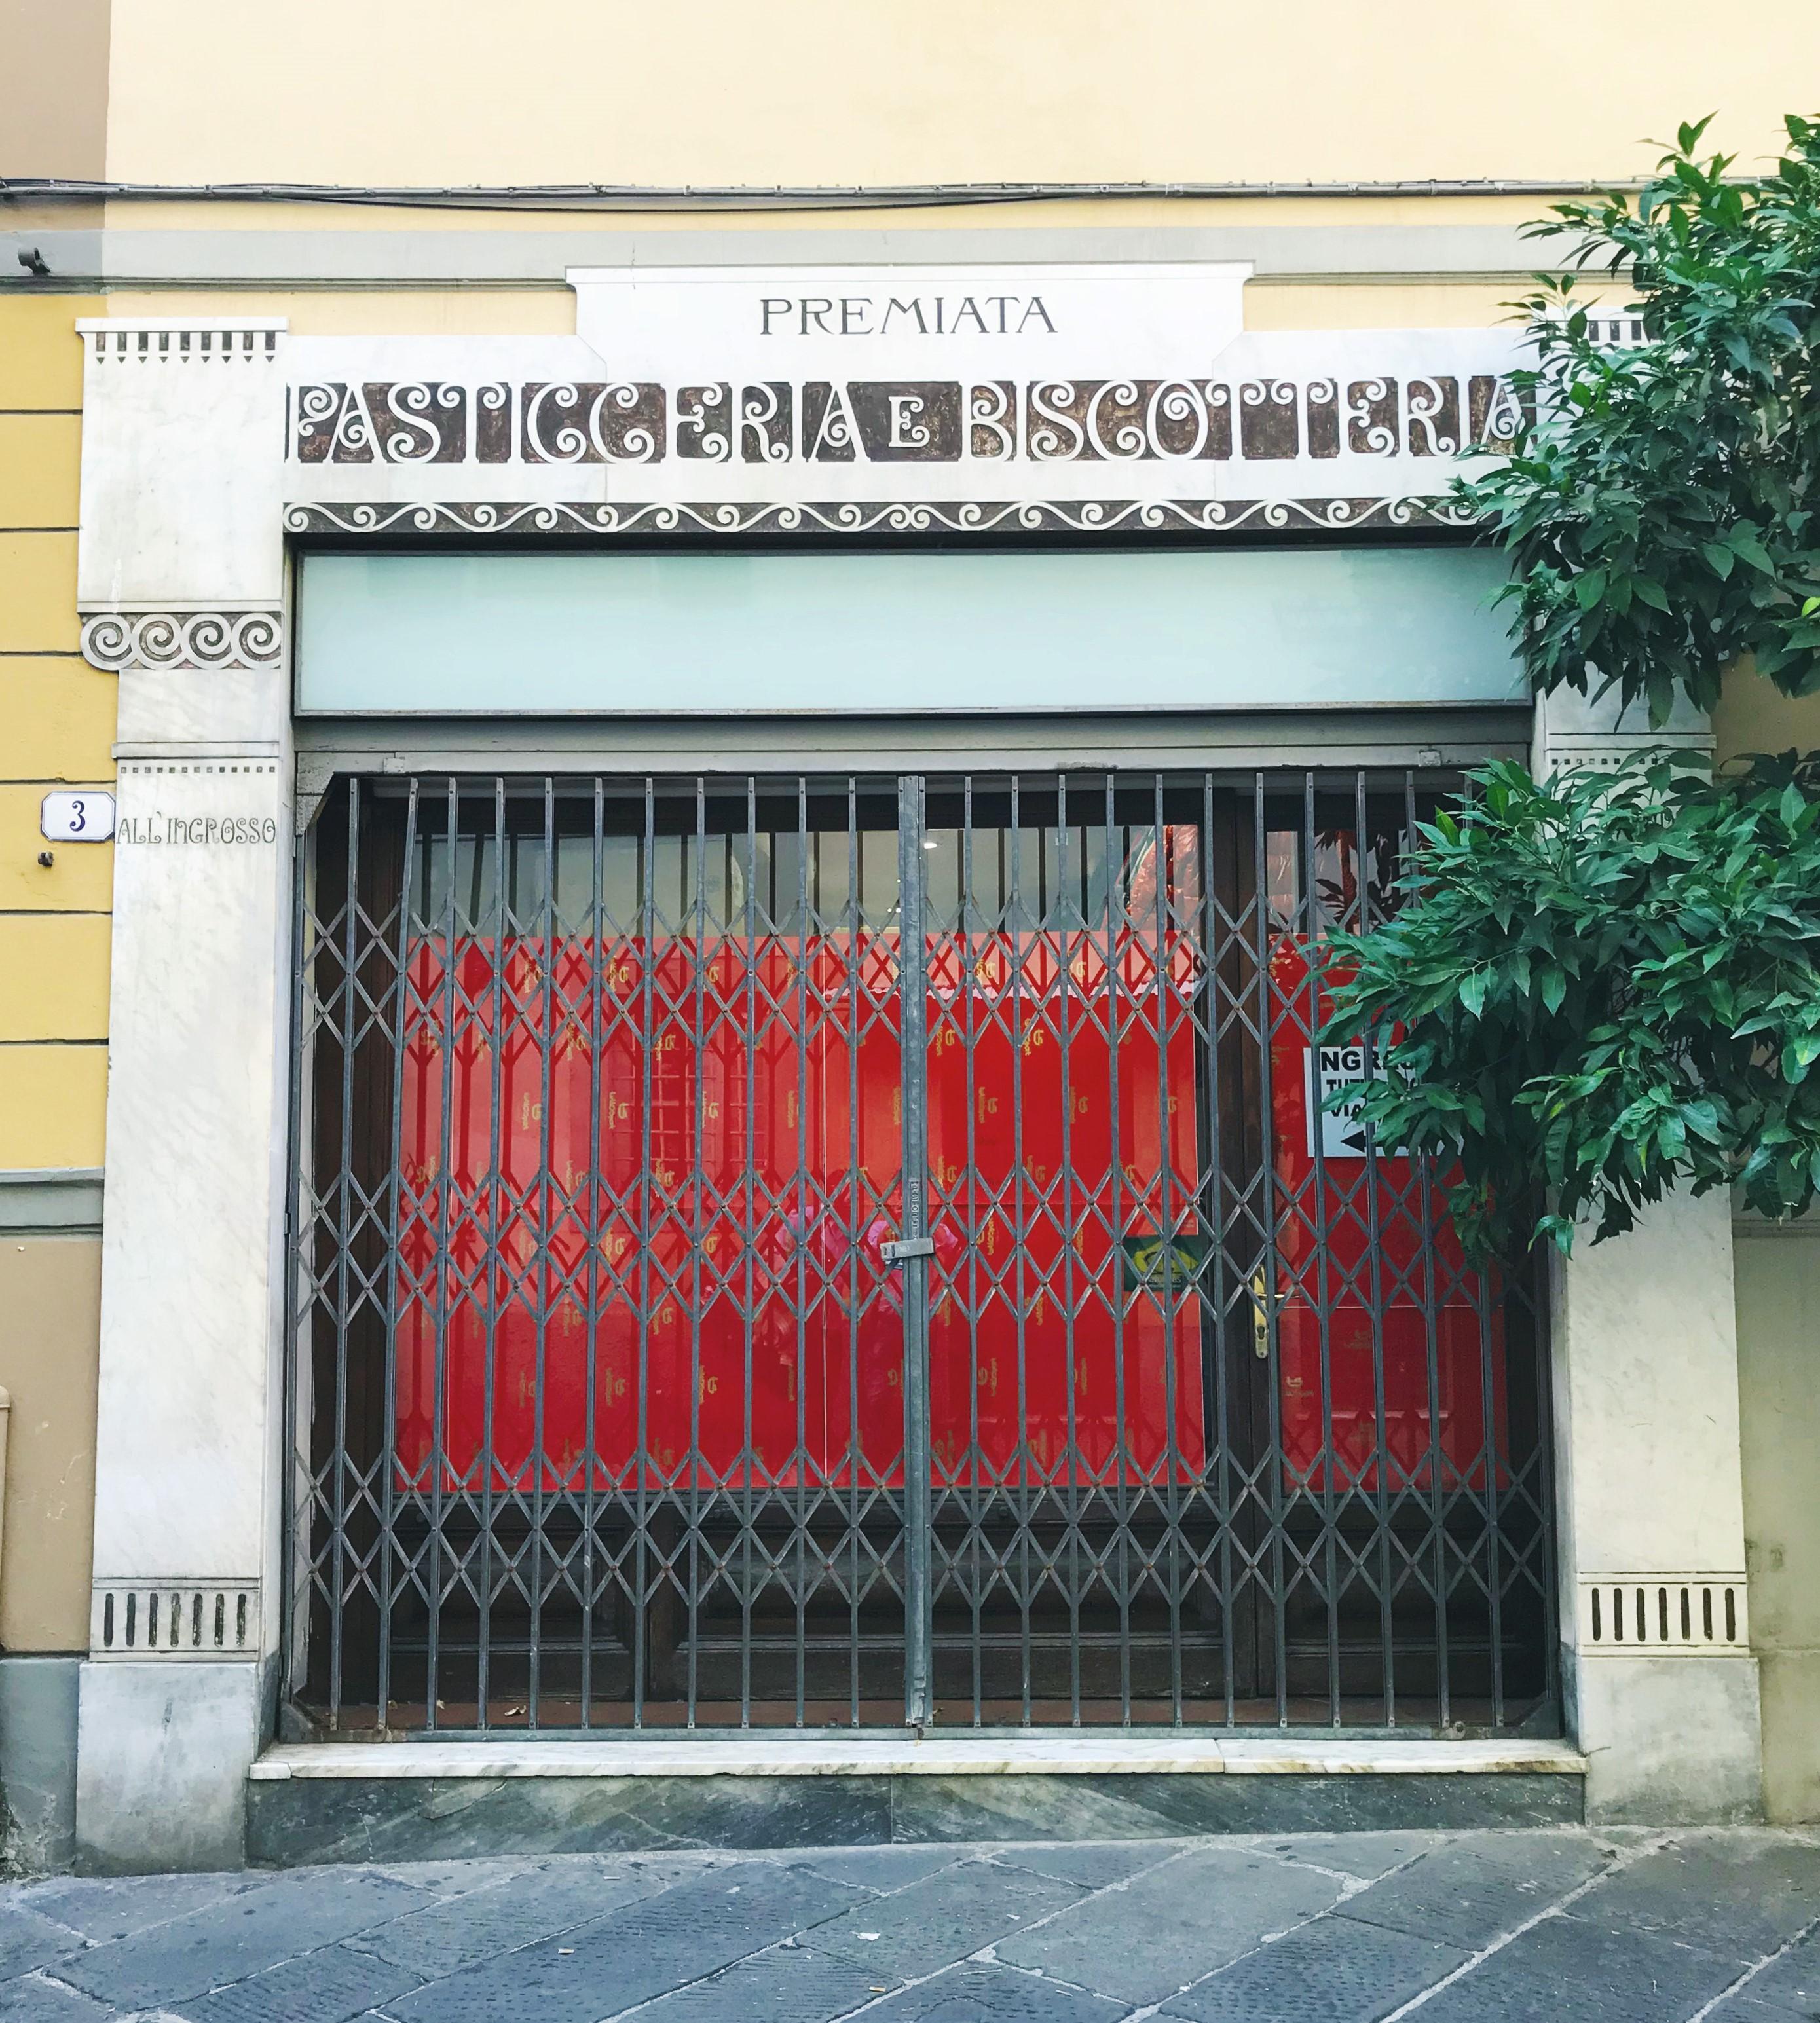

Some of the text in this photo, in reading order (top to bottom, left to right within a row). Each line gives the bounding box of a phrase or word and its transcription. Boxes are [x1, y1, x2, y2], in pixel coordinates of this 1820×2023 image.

[759, 296, 1058, 335] PREMIATA
[287, 376, 1536, 464] PASTICCERIA E BISCOTTERIA
[69, 800, 86, 832] 3
